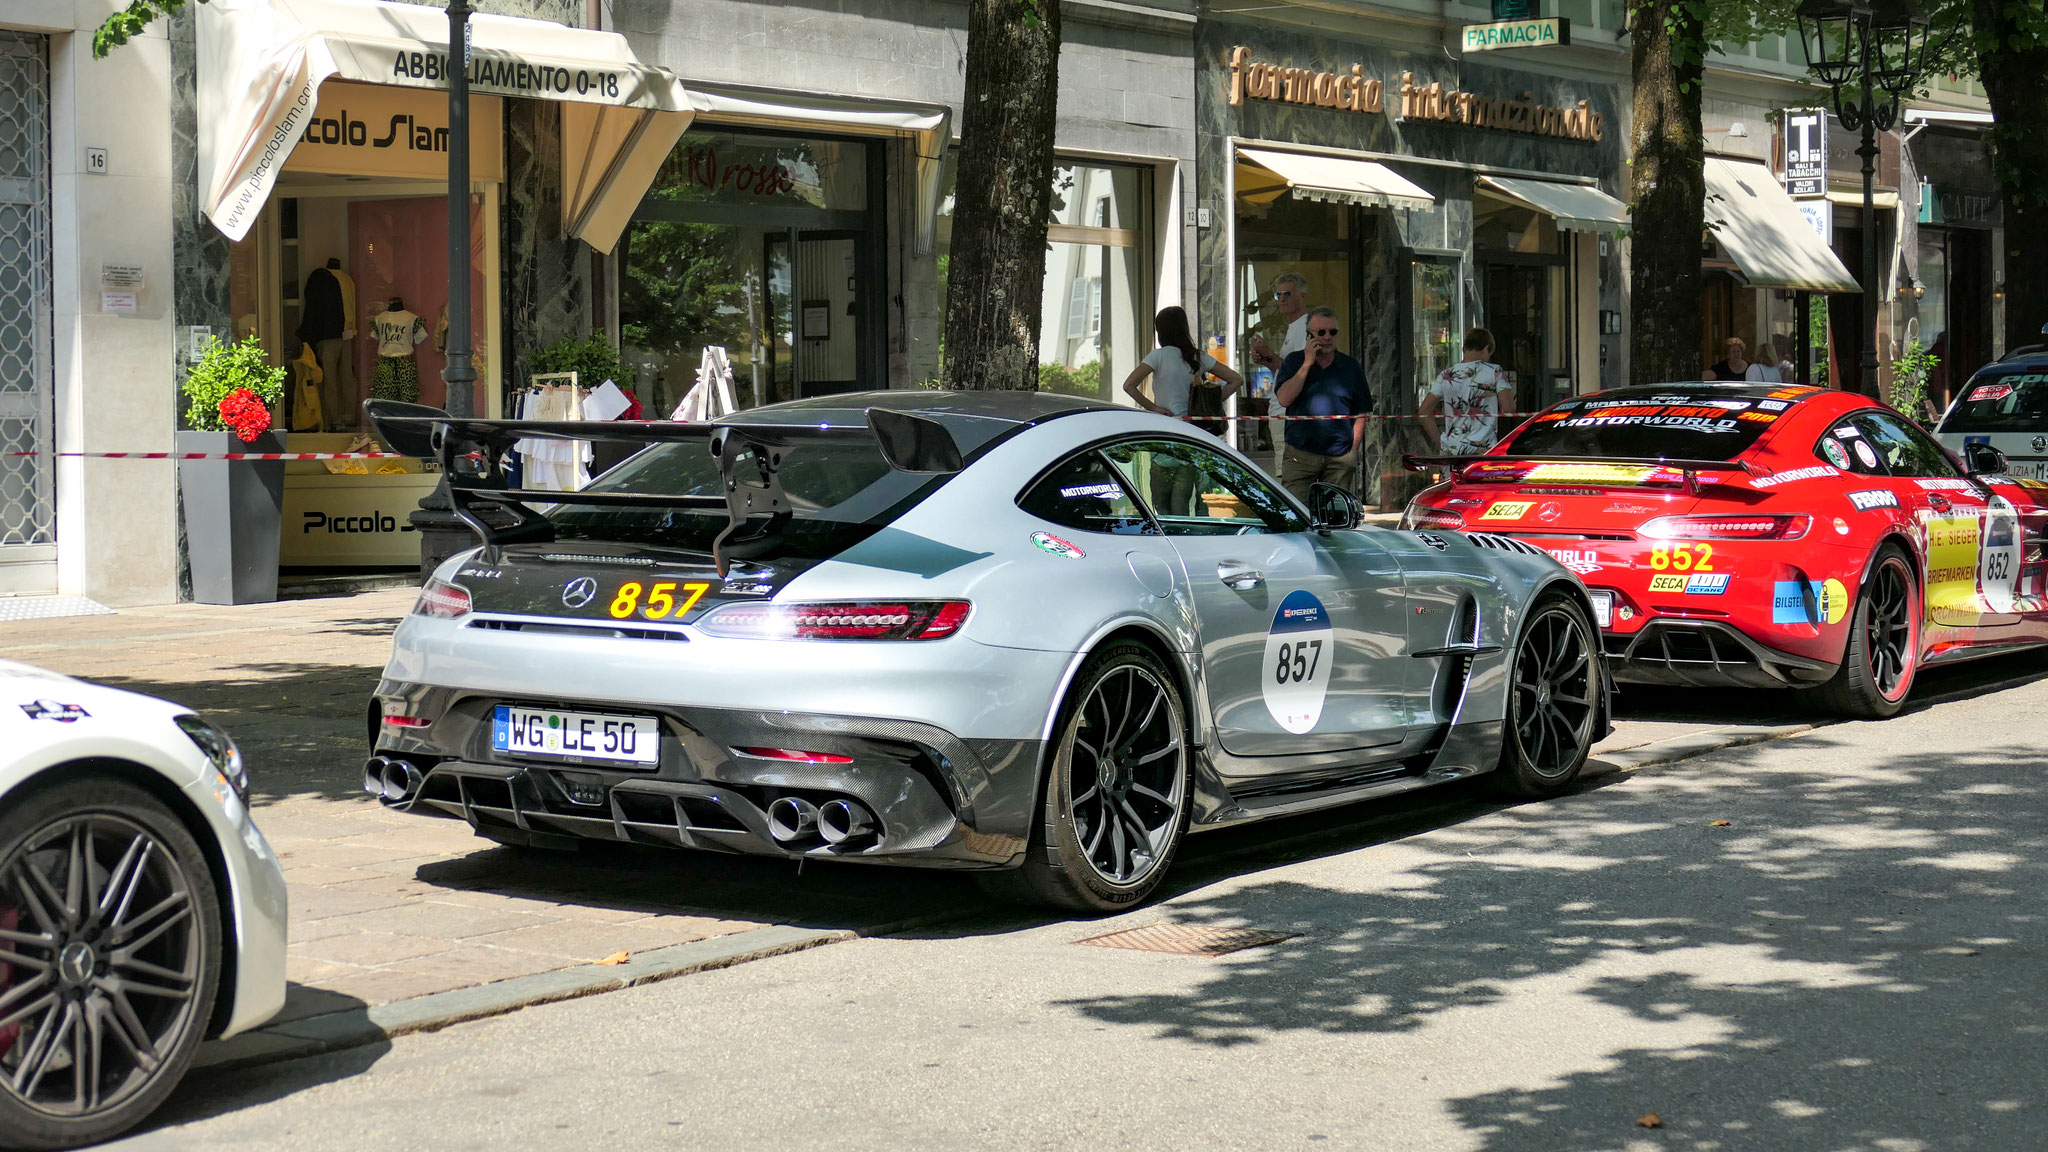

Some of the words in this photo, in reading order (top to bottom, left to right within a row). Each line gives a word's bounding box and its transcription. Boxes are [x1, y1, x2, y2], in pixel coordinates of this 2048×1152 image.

[1467, 23, 1555, 46] FARMACIA
[394, 51, 570, 94] ABBIIAMENTO
[576, 70, 619, 98] 0-18
[1230, 46, 1383, 113] farmacia
[1401, 70, 1603, 142] internazionale
[1792, 116, 1817, 162] T
[91, 154, 104, 168] 16
[1788, 168, 1821, 177] TABACCHI
[1187, 211, 1195, 221] 12
[1200, 213, 1207, 223] 10
[1553, 416, 1737, 428] MOTORWORLD
[1584, 406, 1665, 417] LONDON
[1661, 406, 1728, 418] TOKYO
[1749, 465, 1839, 488] MOTORWORLD
[1061, 484, 1120, 498] MOTORWORLD
[1488, 504, 1528, 517] SECA
[304, 510, 395, 533] Piccolo
[1929, 532, 1945, 547] H.E.
[1949, 529, 1977, 546] SIEGER
[1650, 542, 1713, 571] 852
[1987, 552, 2010, 580] 852
[1653, 577, 1685, 590] SECA
[1927, 566, 1976, 585] BRIEFMARKEN
[609, 582, 710, 619] 857
[1276, 640, 1322, 684] 857
[499, 732, 505, 741] D
[512, 713, 544, 747] WG
[563, 717, 596, 752] LE
[604, 720, 637, 755] 50
